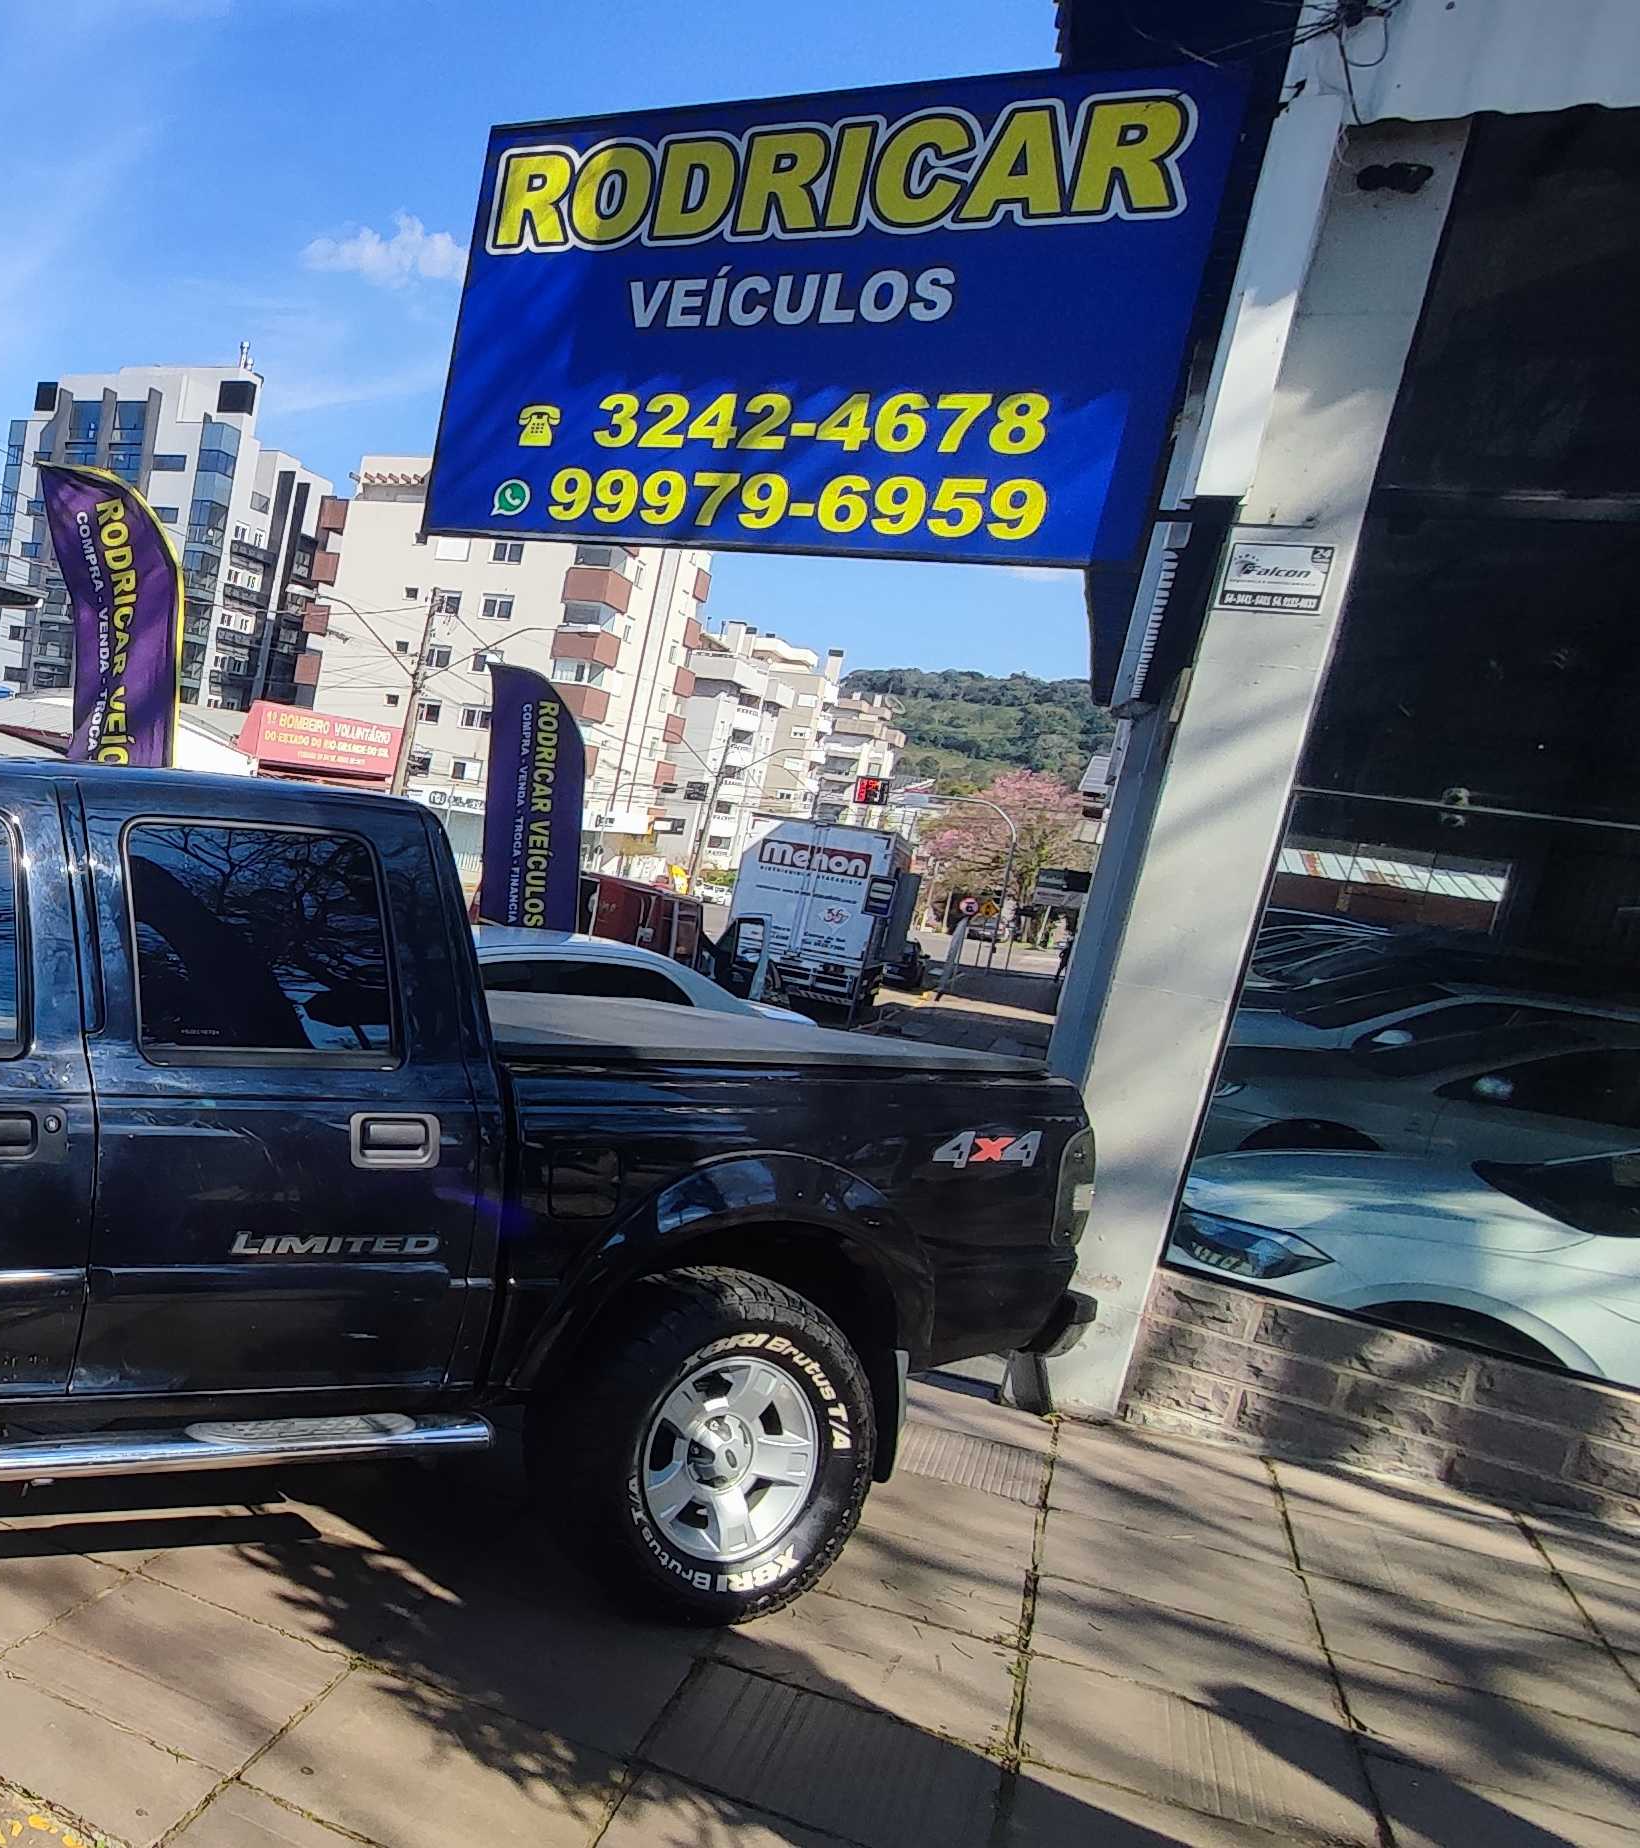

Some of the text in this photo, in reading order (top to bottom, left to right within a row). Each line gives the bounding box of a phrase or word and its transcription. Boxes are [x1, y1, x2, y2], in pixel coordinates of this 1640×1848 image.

[486, 89, 1199, 256] RODRICAR
[630, 265, 955, 329] VEÍCULOS
[593, 392, 1050, 455] 3242-4678
[548, 467, 1048, 541] 99979-6959
[76, 511, 104, 593] COMPRA
[1240, 563, 1311, 578] Falcon
[96, 498, 138, 677] RODRICAR
[97, 607, 110, 673] VENDA
[87, 689, 108, 751] TROCA
[279, 713, 330, 735] BOMBEIRO
[519, 703, 533, 756] COMPRA
[516, 765, 529, 807] VENDA
[523, 701, 560, 927] RODRICAR VEÍCULOS
[511, 816, 524, 858] TROCA
[231, 1231, 441, 1255] LIMITED
[766, 1336, 838, 1401] Brutus
[828, 1402, 852, 1450] T/A
[641, 1526, 711, 1591] Brutus
